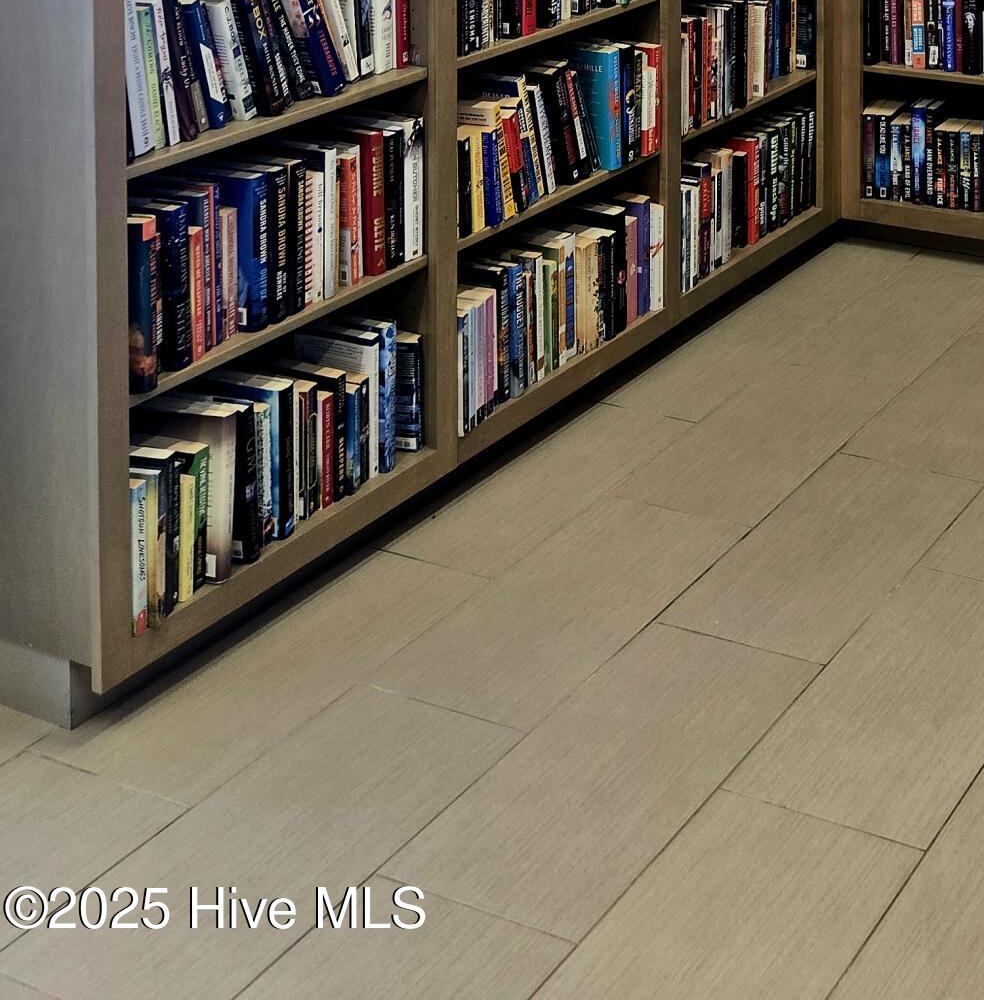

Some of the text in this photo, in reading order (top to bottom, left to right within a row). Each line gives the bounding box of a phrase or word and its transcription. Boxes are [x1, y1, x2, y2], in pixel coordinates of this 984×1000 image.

[252, 7, 265, 41] BOX
[278, 186, 288, 267] SANDRA BROWN
[516, 294, 524, 329] NUGGET
